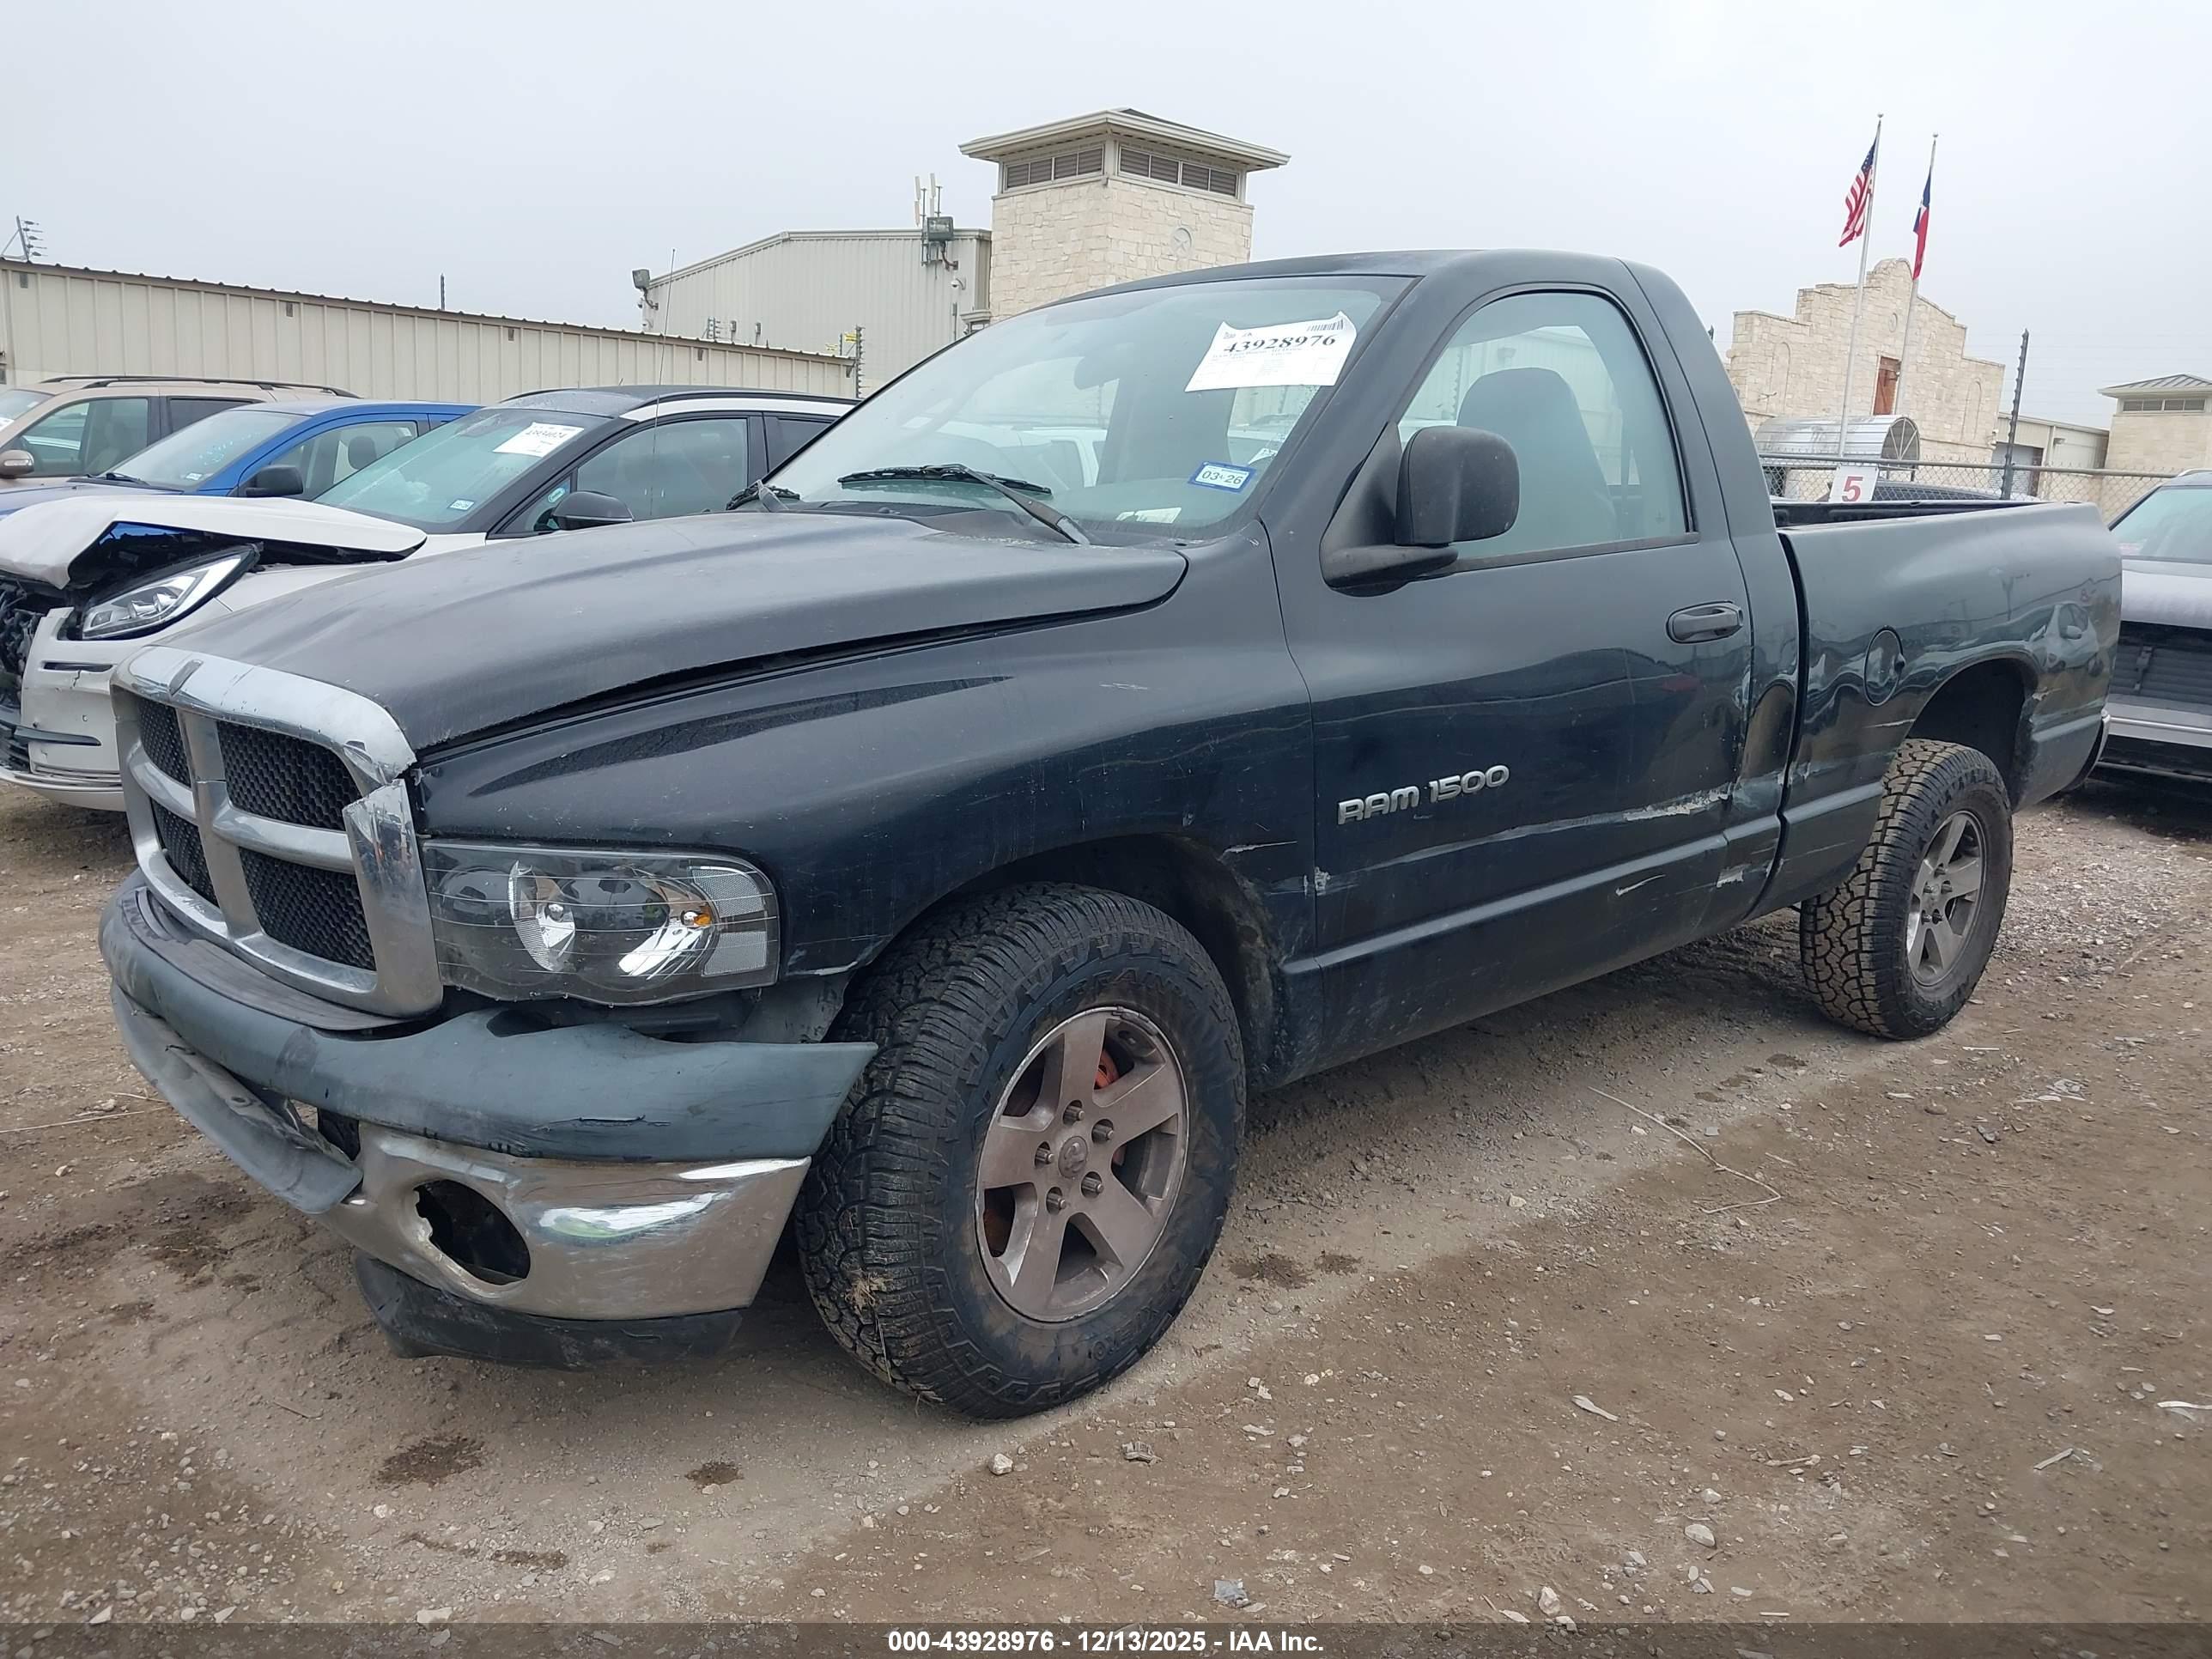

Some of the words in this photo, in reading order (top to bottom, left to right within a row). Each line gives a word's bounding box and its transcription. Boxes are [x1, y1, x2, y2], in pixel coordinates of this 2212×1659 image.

[1224, 335, 1335, 353] 43928976
[1842, 476, 1863, 502] 5
[1338, 786, 1420, 824] RAM
[1429, 764, 1510, 803] 1500
